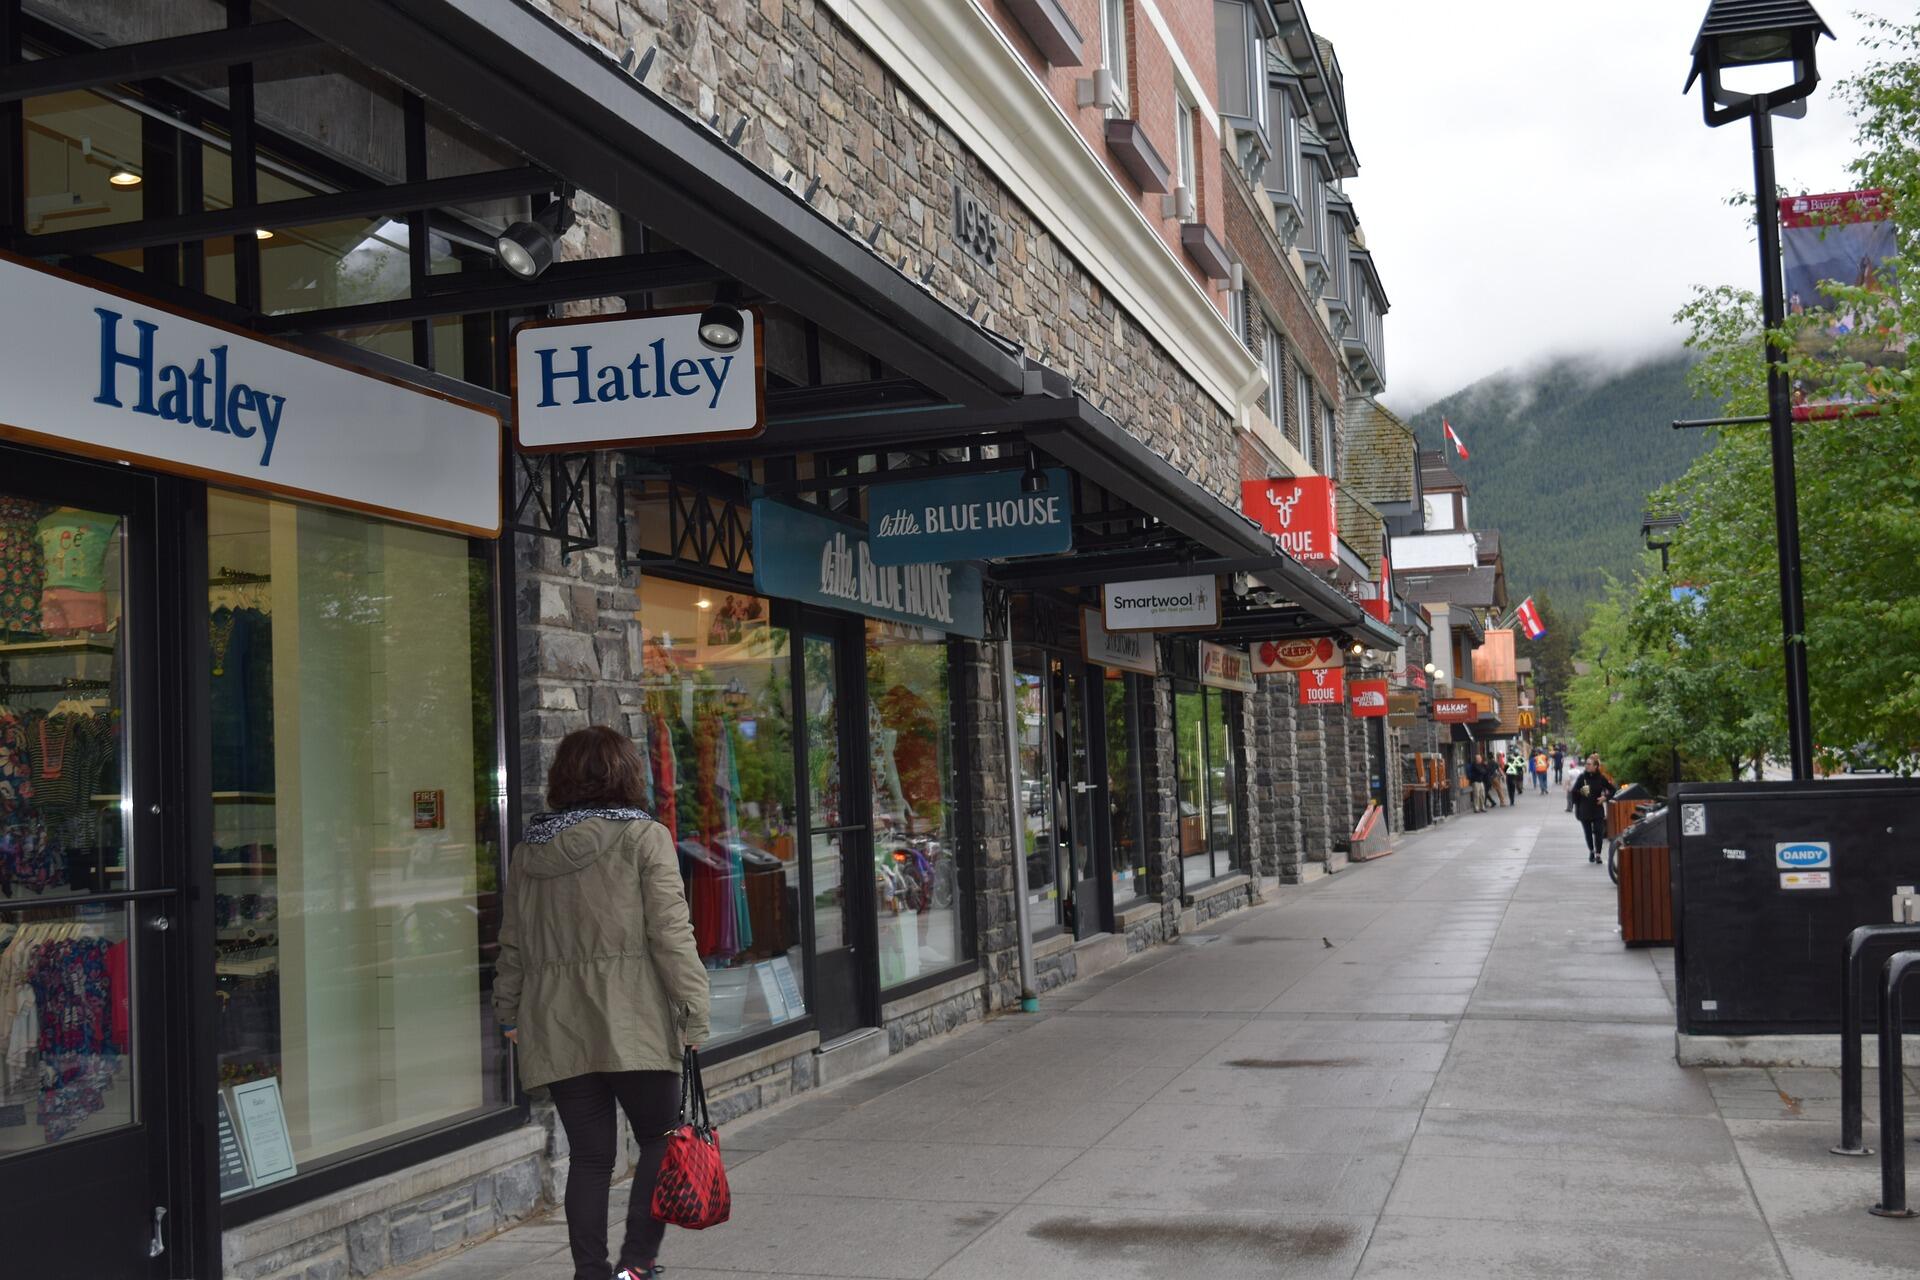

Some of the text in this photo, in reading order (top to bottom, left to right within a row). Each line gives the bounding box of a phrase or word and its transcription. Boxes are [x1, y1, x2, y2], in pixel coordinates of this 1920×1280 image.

[954, 184, 998, 265] 1955
[94, 307, 286, 466] Hatley
[535, 337, 735, 408] Hatley
[877, 496, 1061, 537] little BLUE HOUSE
[819, 532, 859, 600] little
[1303, 552, 1324, 560] PUB
[1114, 592, 1193, 609] Smartwool
[1307, 687, 1335, 701] TOQUE
[1783, 850, 1823, 860] DANDY
